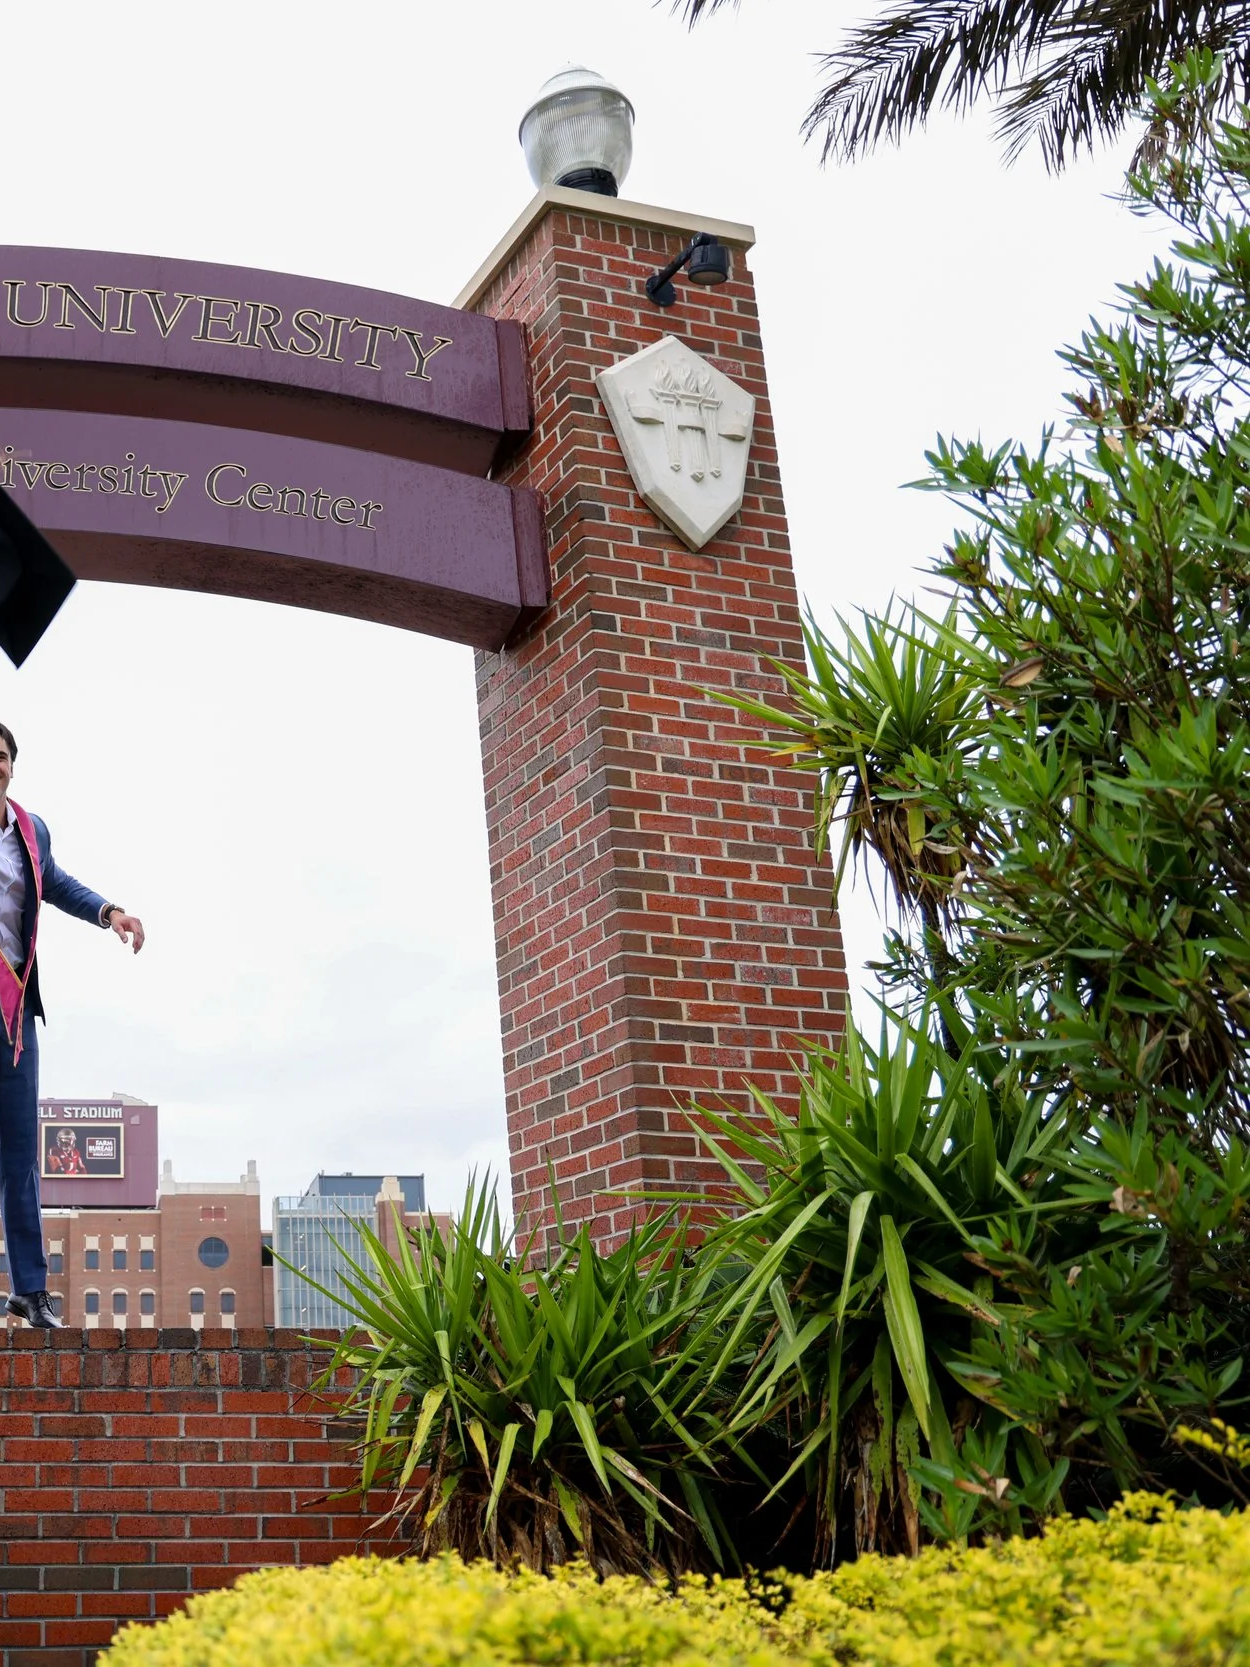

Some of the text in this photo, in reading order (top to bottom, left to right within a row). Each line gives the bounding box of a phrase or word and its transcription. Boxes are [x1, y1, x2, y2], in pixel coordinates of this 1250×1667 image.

[2, 279, 452, 382] UNIVERSITY
[205, 462, 382, 531] Center
[38, 1107, 123, 1118] LL STADIUM
